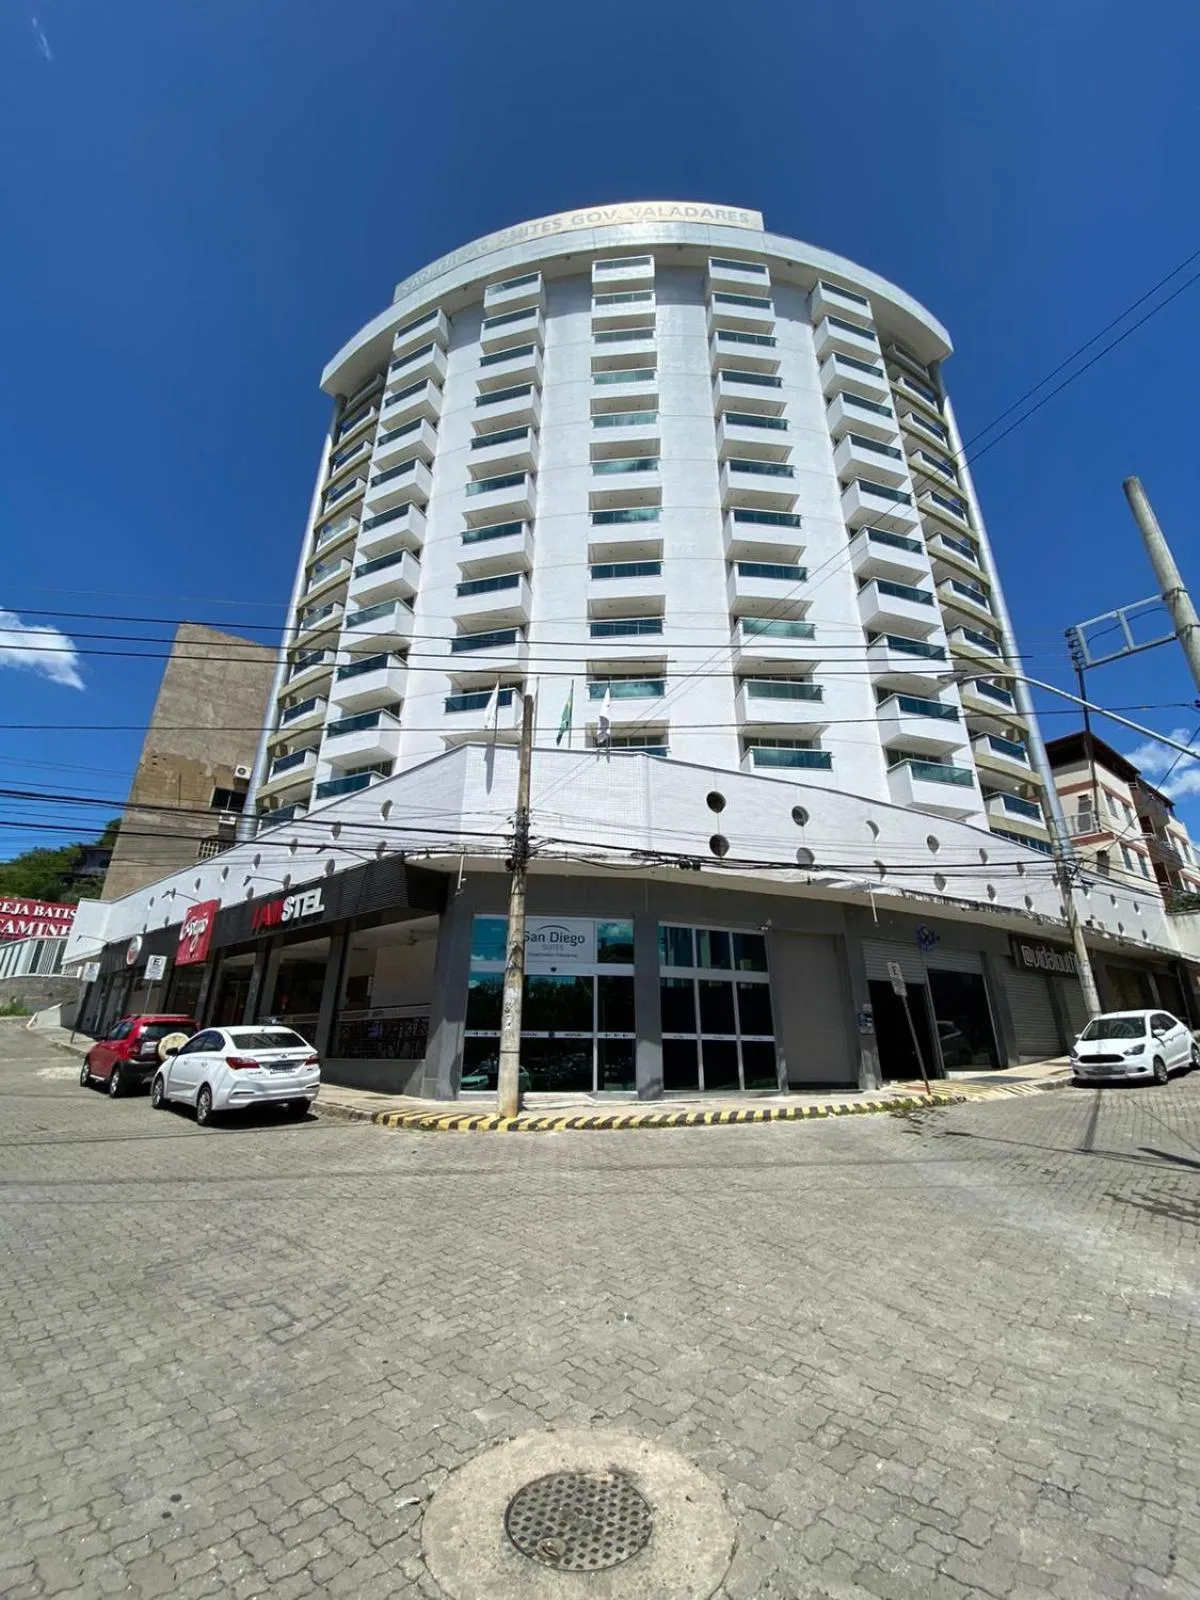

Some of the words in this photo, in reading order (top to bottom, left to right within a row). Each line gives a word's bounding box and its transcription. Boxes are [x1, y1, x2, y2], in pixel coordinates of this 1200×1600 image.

[500, 219, 562, 244] SUITES
[571, 210, 622, 225] GOV.
[631, 206, 750, 224] VALADARES
[0, 901, 29, 915] EJA
[524, 931, 545, 942] San
[550, 931, 585, 947] Diego
